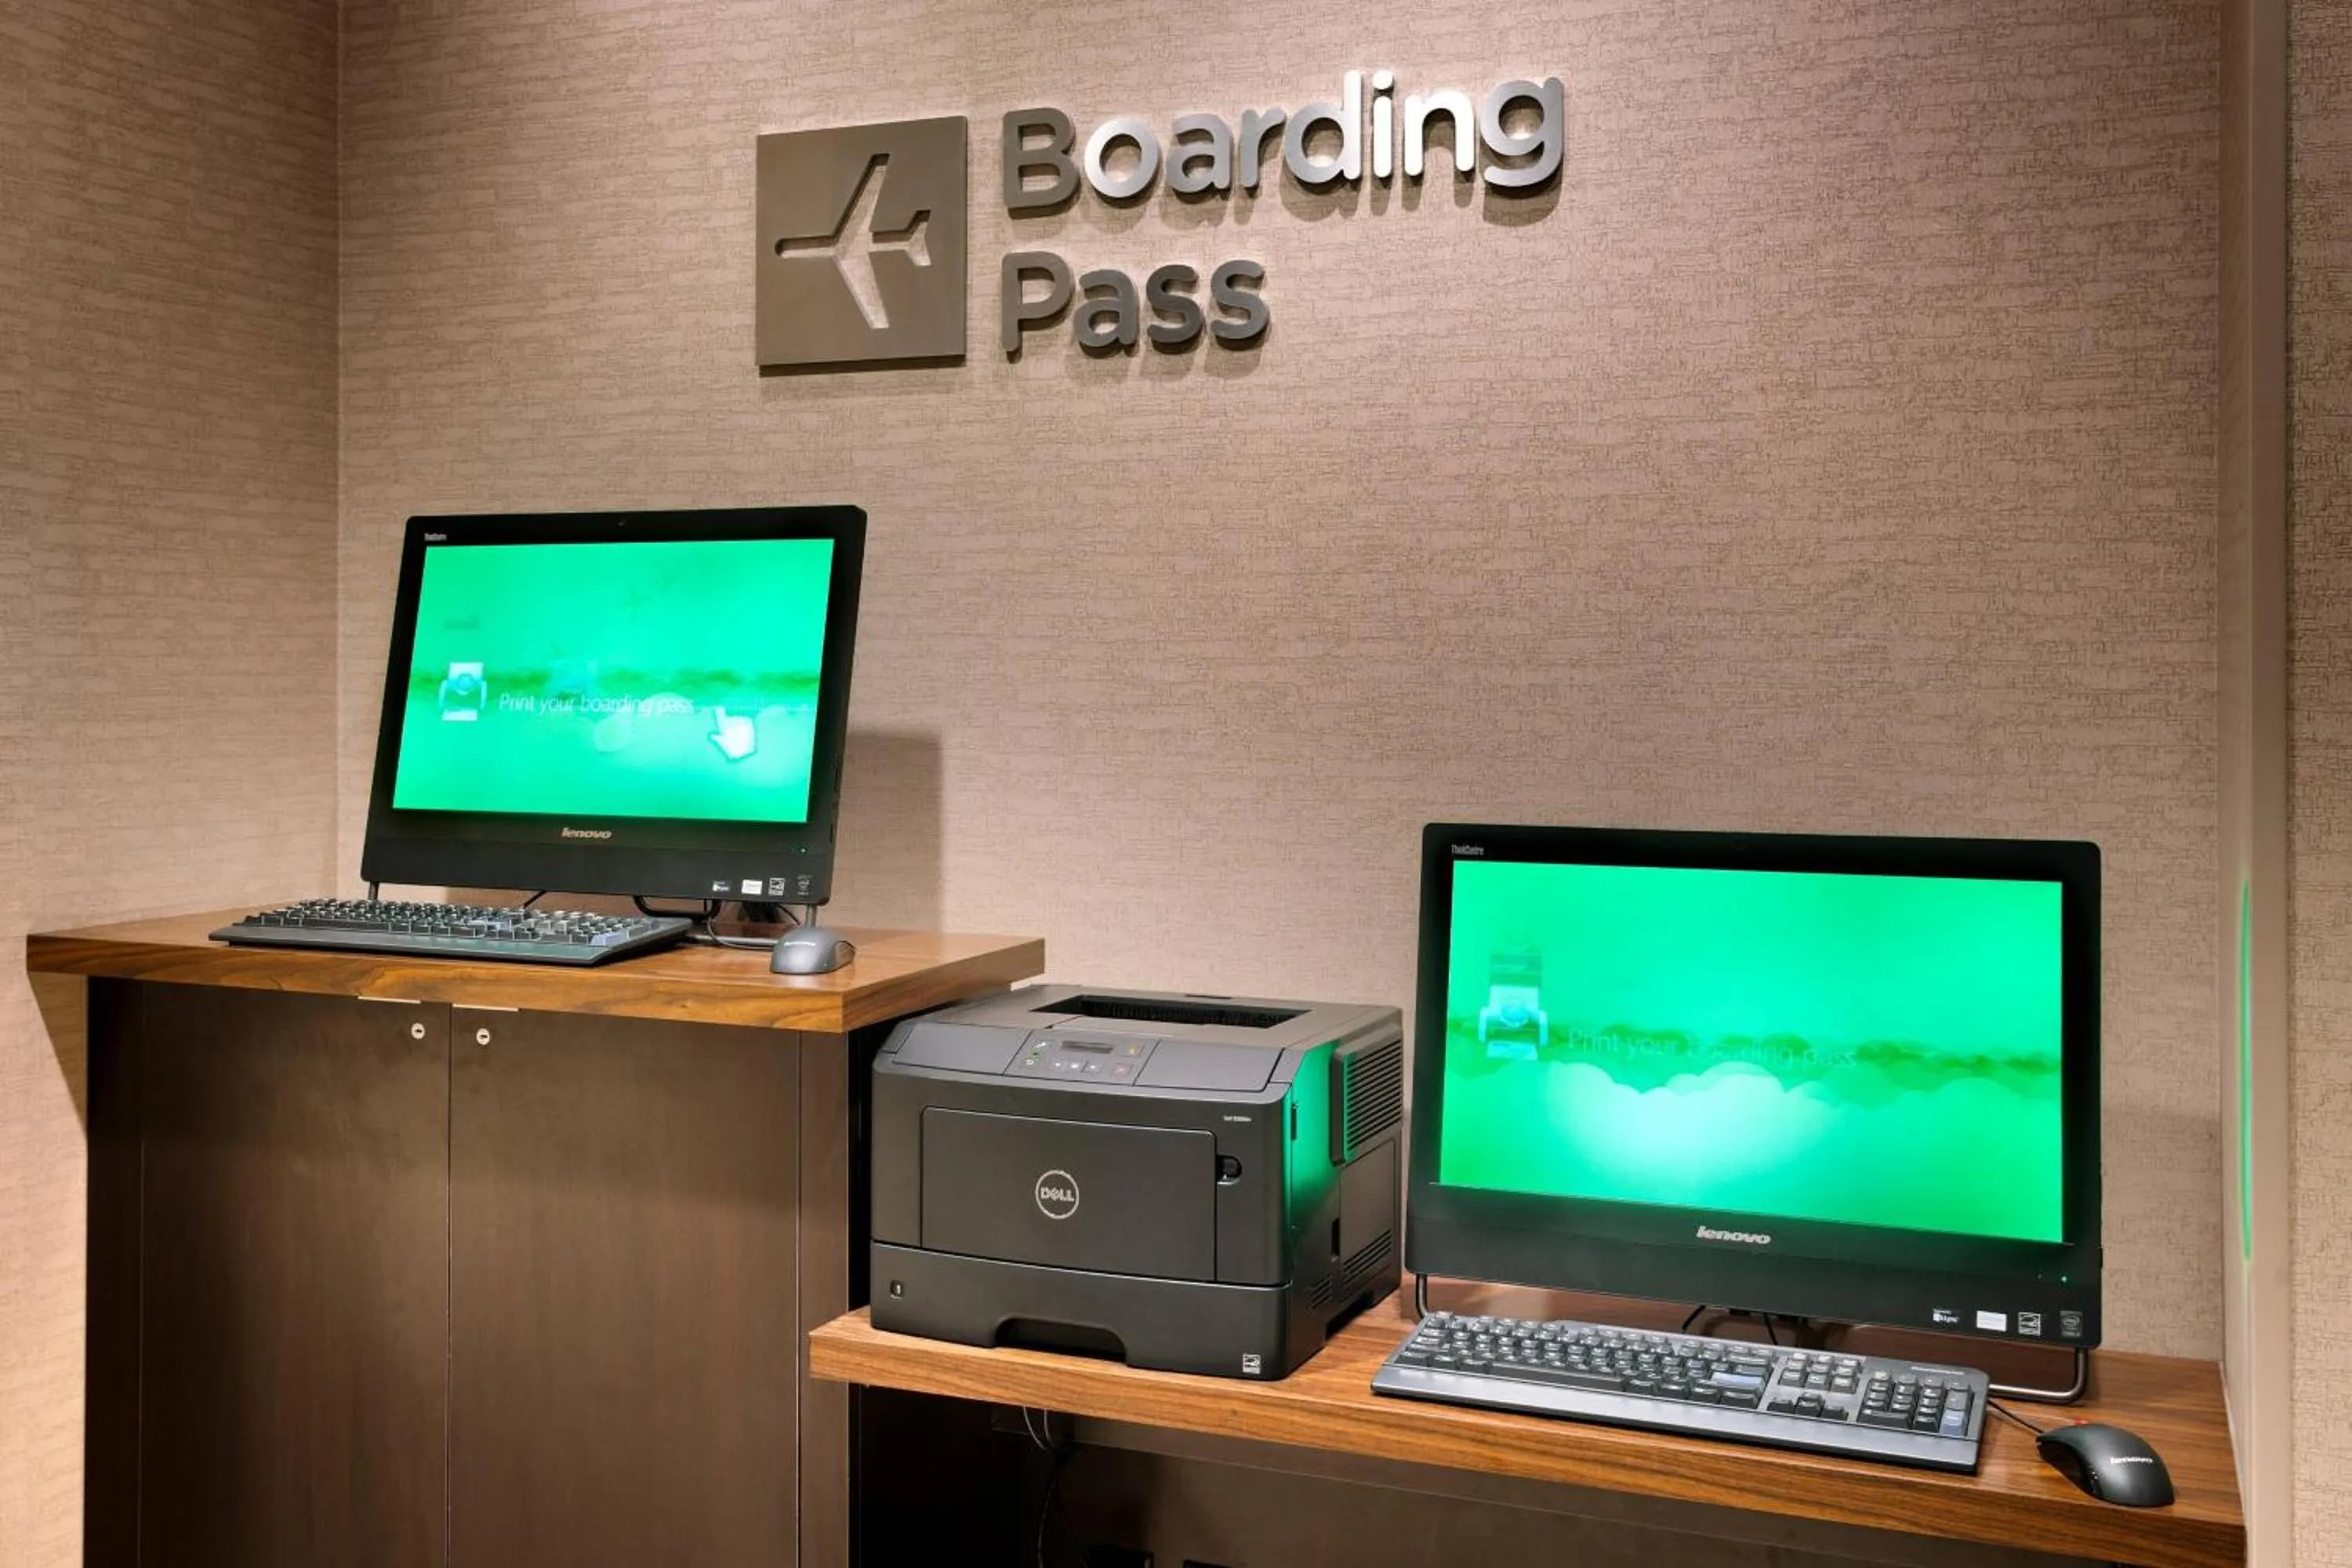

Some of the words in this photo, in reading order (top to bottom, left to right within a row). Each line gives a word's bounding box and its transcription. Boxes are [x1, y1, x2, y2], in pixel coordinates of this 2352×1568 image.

[1003, 69, 1564, 209] Boarding
[1001, 250, 1270, 352] Pass
[499, 691, 535, 712] Print
[539, 696, 575, 716] your
[581, 694, 652, 717] boarding
[561, 827, 612, 840] lenovo
[1568, 1028, 1619, 1053] Print
[1628, 1036, 1679, 1060] your
[1802, 1048, 1858, 1069] pass
[1040, 1186, 1075, 1202] DELL
[1696, 1225, 1771, 1244] lenovo
